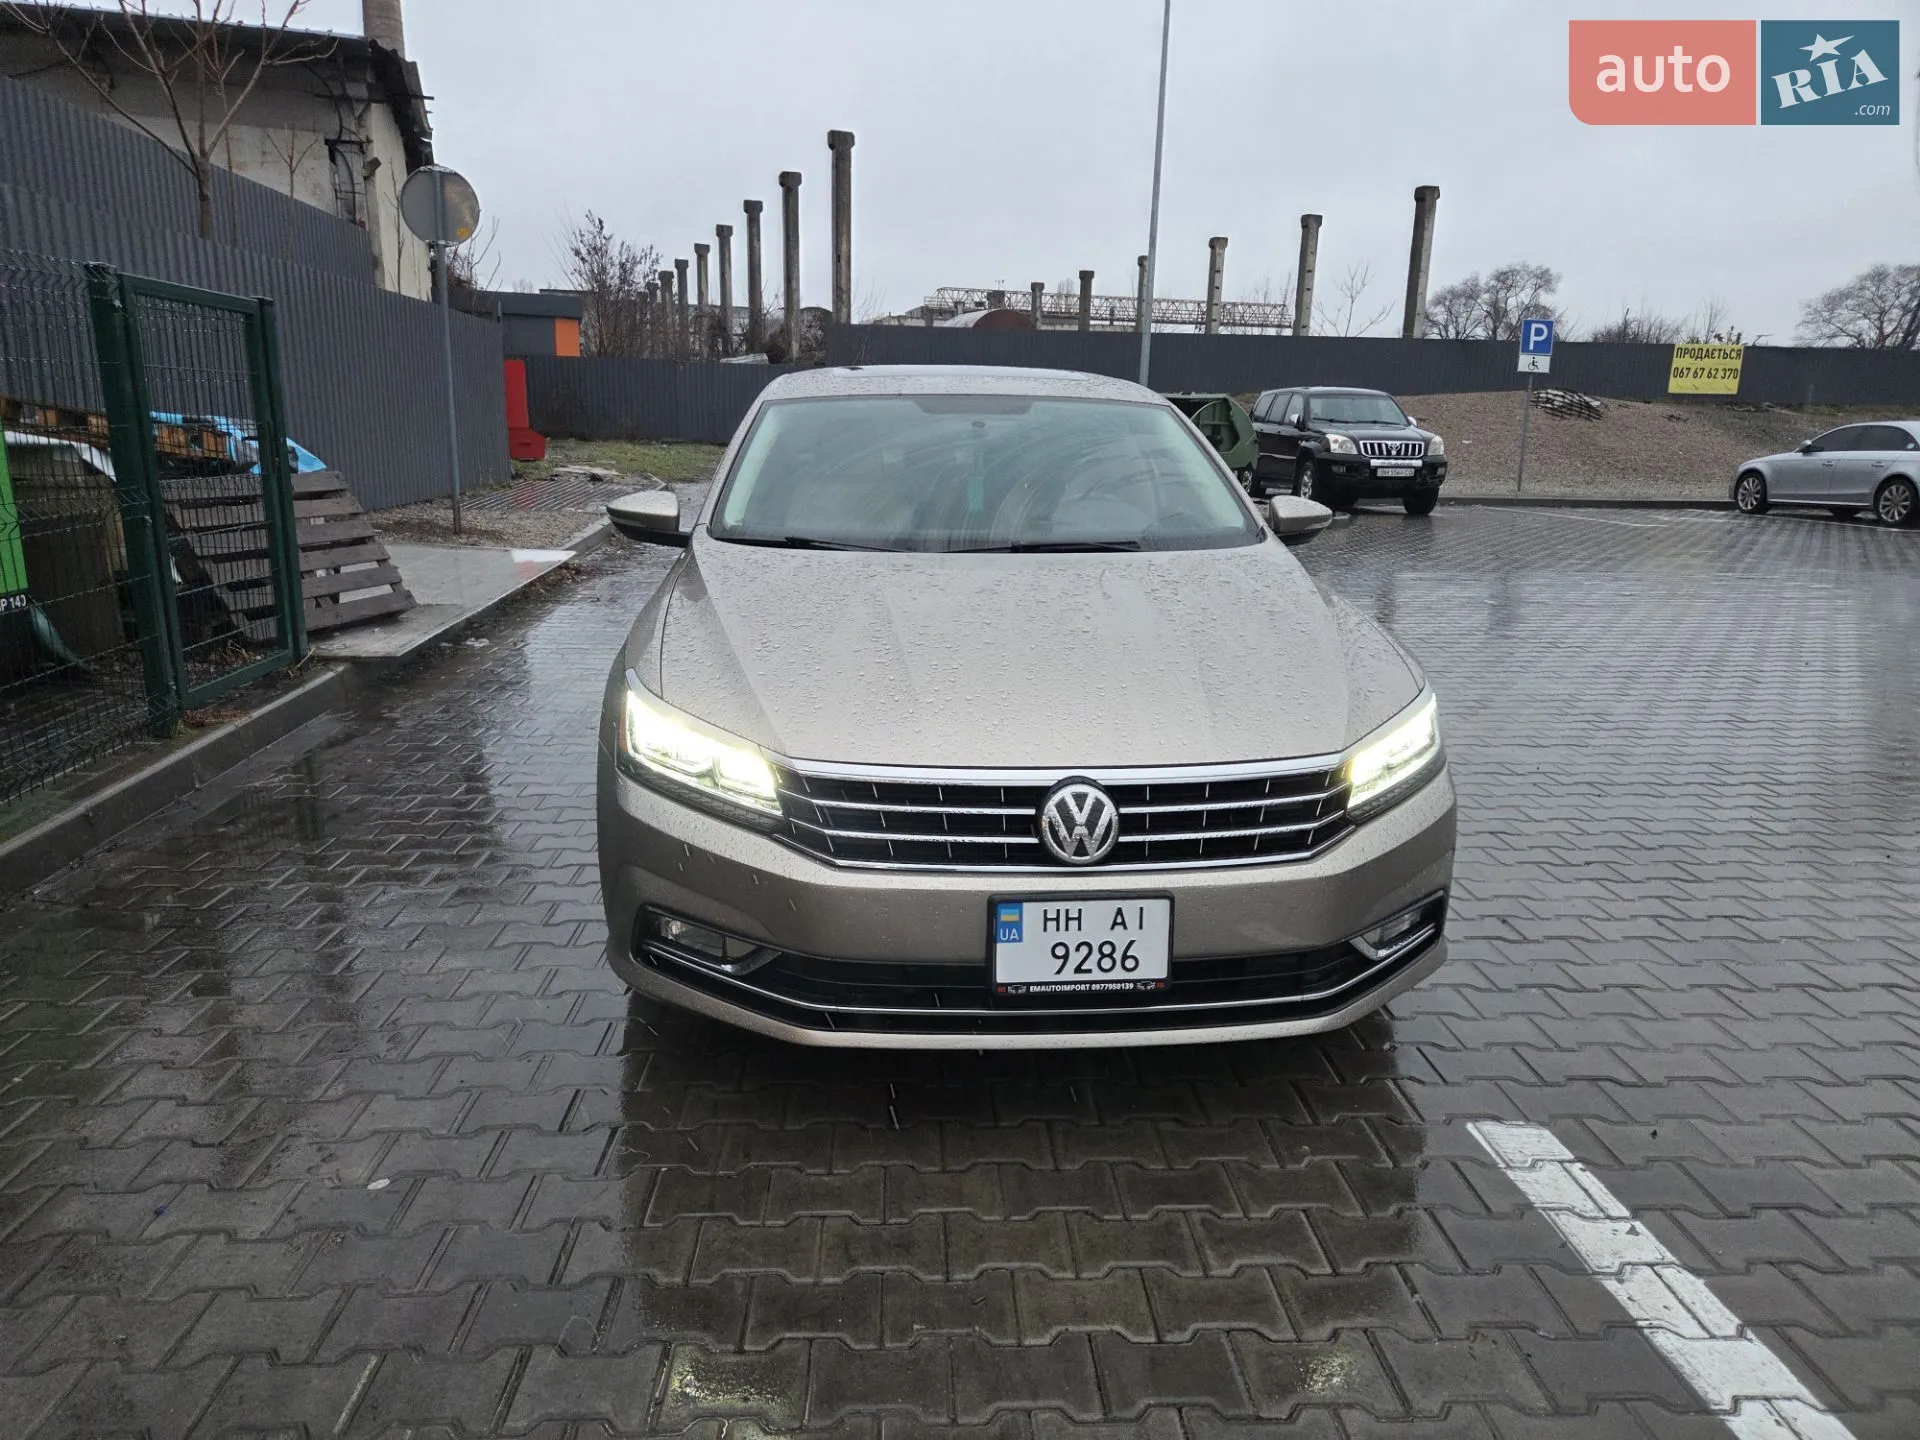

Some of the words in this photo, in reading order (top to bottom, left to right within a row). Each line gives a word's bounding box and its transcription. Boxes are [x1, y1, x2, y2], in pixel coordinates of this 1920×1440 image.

[1529, 322, 1548, 351] P
[1675, 347, 1742, 361] ПРОДАЄТЬСЯ
[1672, 367, 1691, 379] 067
[1692, 367, 1705, 379] 67
[1706, 367, 1719, 379] 62
[1721, 368, 1739, 380] 370
[1042, 907, 1083, 933] HH
[1110, 906, 1144, 931] AI
[999, 928, 1020, 941] UA
[1050, 939, 1140, 976] 9286
[1029, 984, 1090, 993] EMAUTOIMPORT
